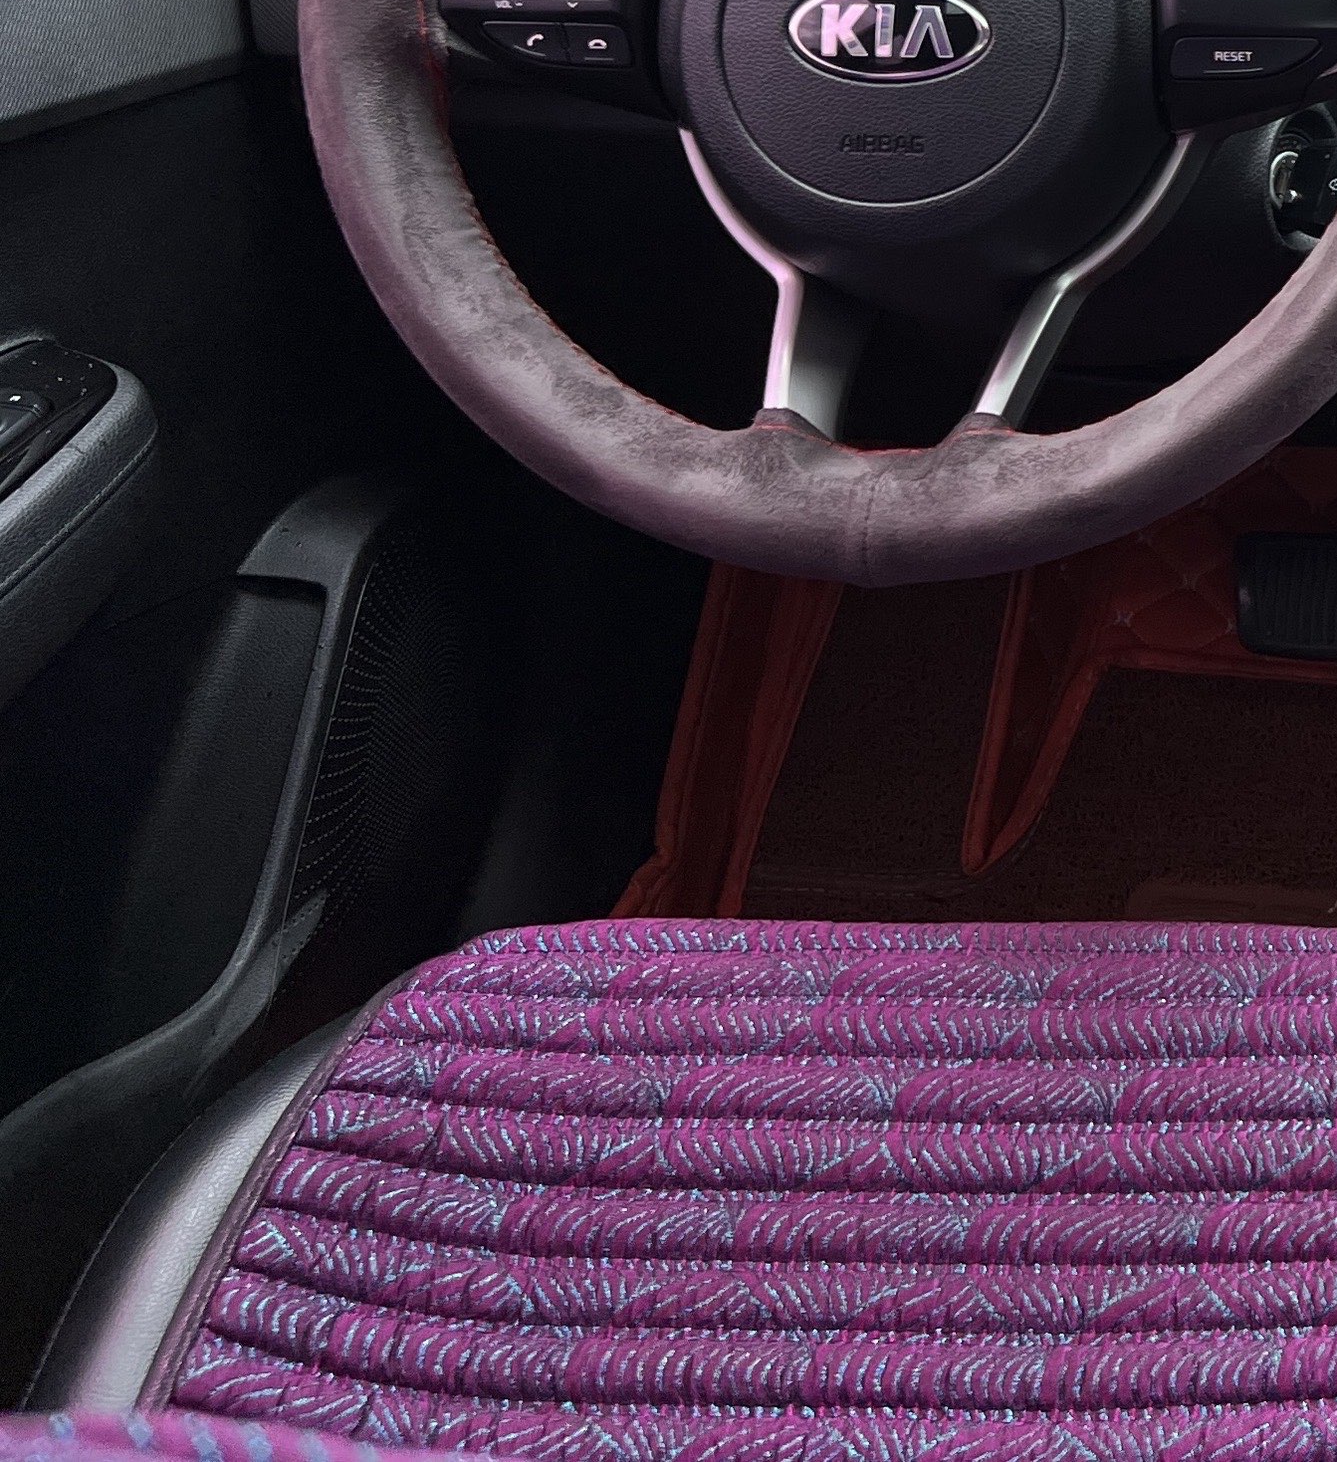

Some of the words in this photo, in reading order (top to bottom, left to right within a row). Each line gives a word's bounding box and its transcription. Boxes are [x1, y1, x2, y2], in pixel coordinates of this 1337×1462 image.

[820, 3, 954, 60] KIA
[1214, 50, 1253, 63] RESET
[840, 134, 926, 156] AIRBAG
